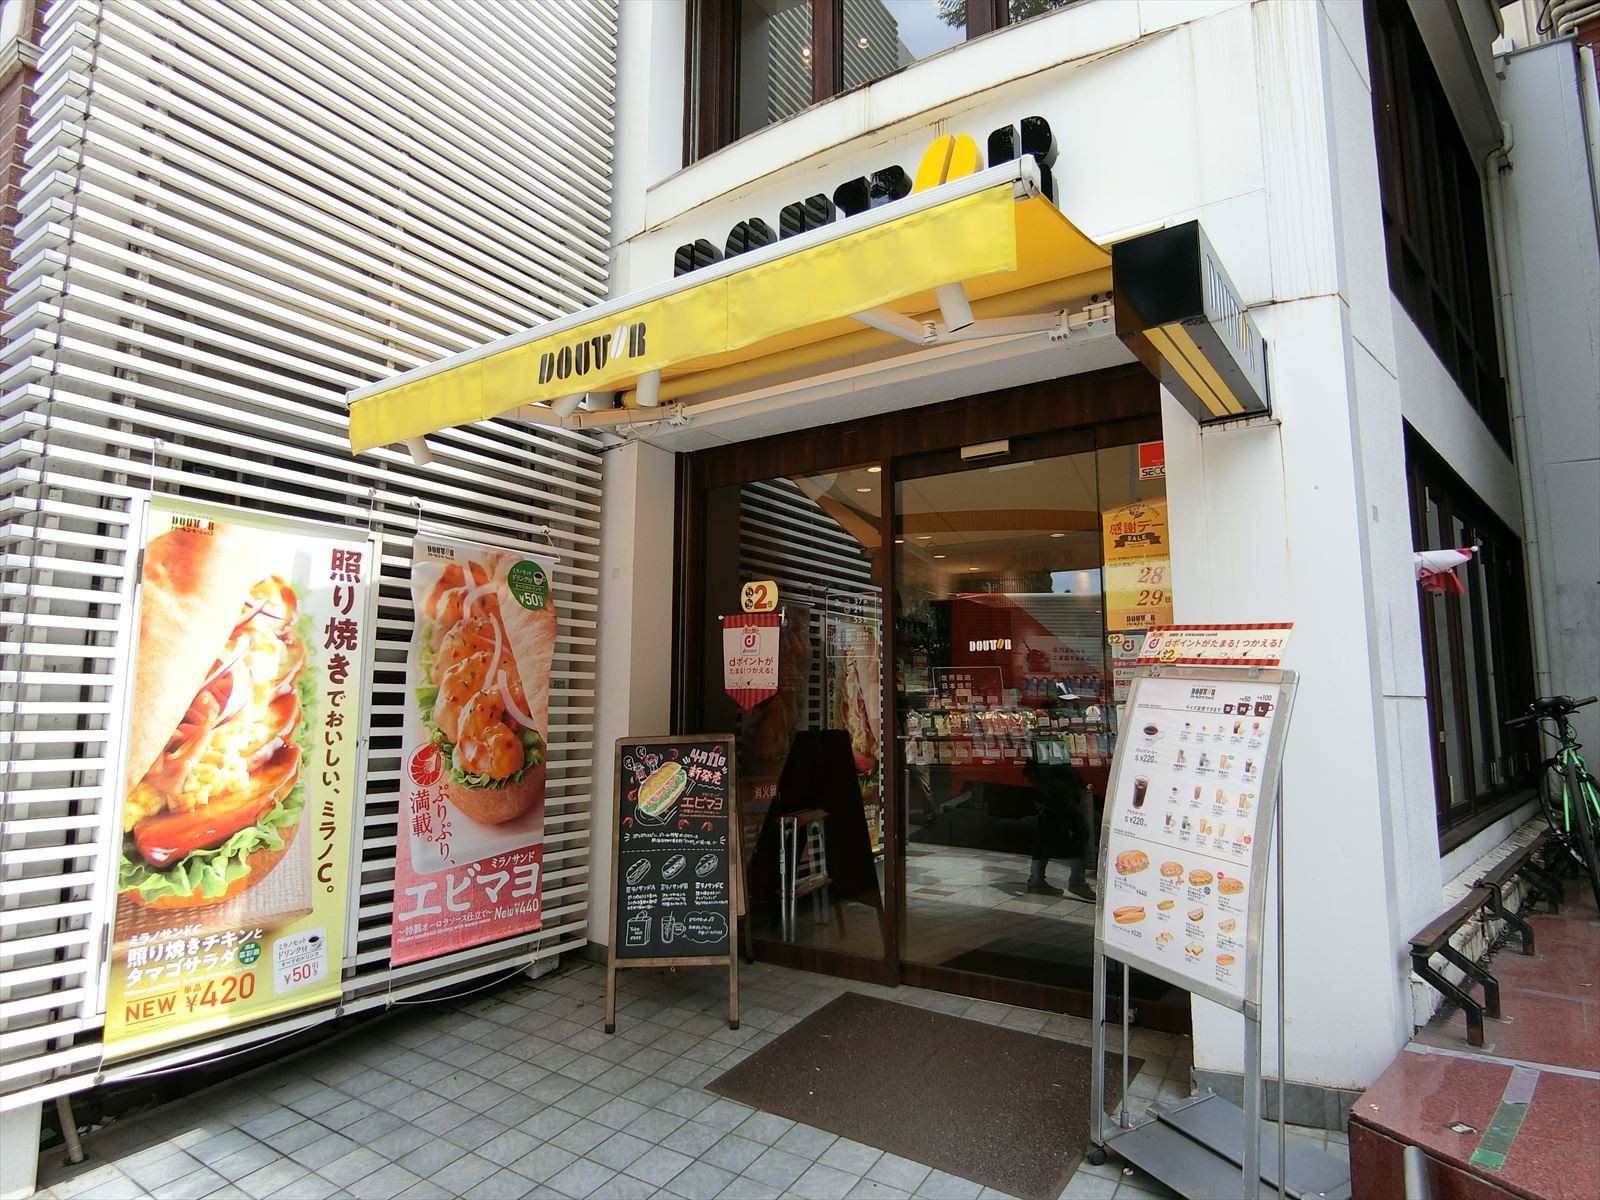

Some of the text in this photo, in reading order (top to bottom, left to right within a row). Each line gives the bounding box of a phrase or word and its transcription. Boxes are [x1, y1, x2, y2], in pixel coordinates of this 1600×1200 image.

[538, 322, 646, 384] DOUTOR
[1142, 467, 1165, 476] SECO
[172, 516, 214, 530] DOUTR
[1110, 519, 1164, 535] 感謝デー
[969, 638, 1011, 652] DOUTOR
[730, 656, 773, 666] dポイントが
[316, 548, 362, 893] 照り焼きでおいしい、ミラノC。
[690, 748, 726, 768] 4月11日
[1140, 755, 1154, 764] ¥220
[688, 764, 722, 785] 新発売
[681, 796, 723, 810] エビマヨ
[410, 789, 433, 842] 満載。
[433, 784, 455, 864] ぷりぷり、
[1129, 816, 1144, 825] ¥220
[491, 851, 535, 868] ミラノサンド
[398, 863, 539, 922] エビマヨ
[494, 906, 513, 920] New
[130, 924, 202, 945] ミラノサンドC
[127, 929, 262, 968] 照り焼きチキンと
[279, 937, 306, 950] ミラノセット
[278, 945, 308, 960] ドリンク付
[127, 947, 239, 988] タマゴサラダ
[125, 995, 177, 1022] NEW
[186, 972, 255, 1013] ¥420
